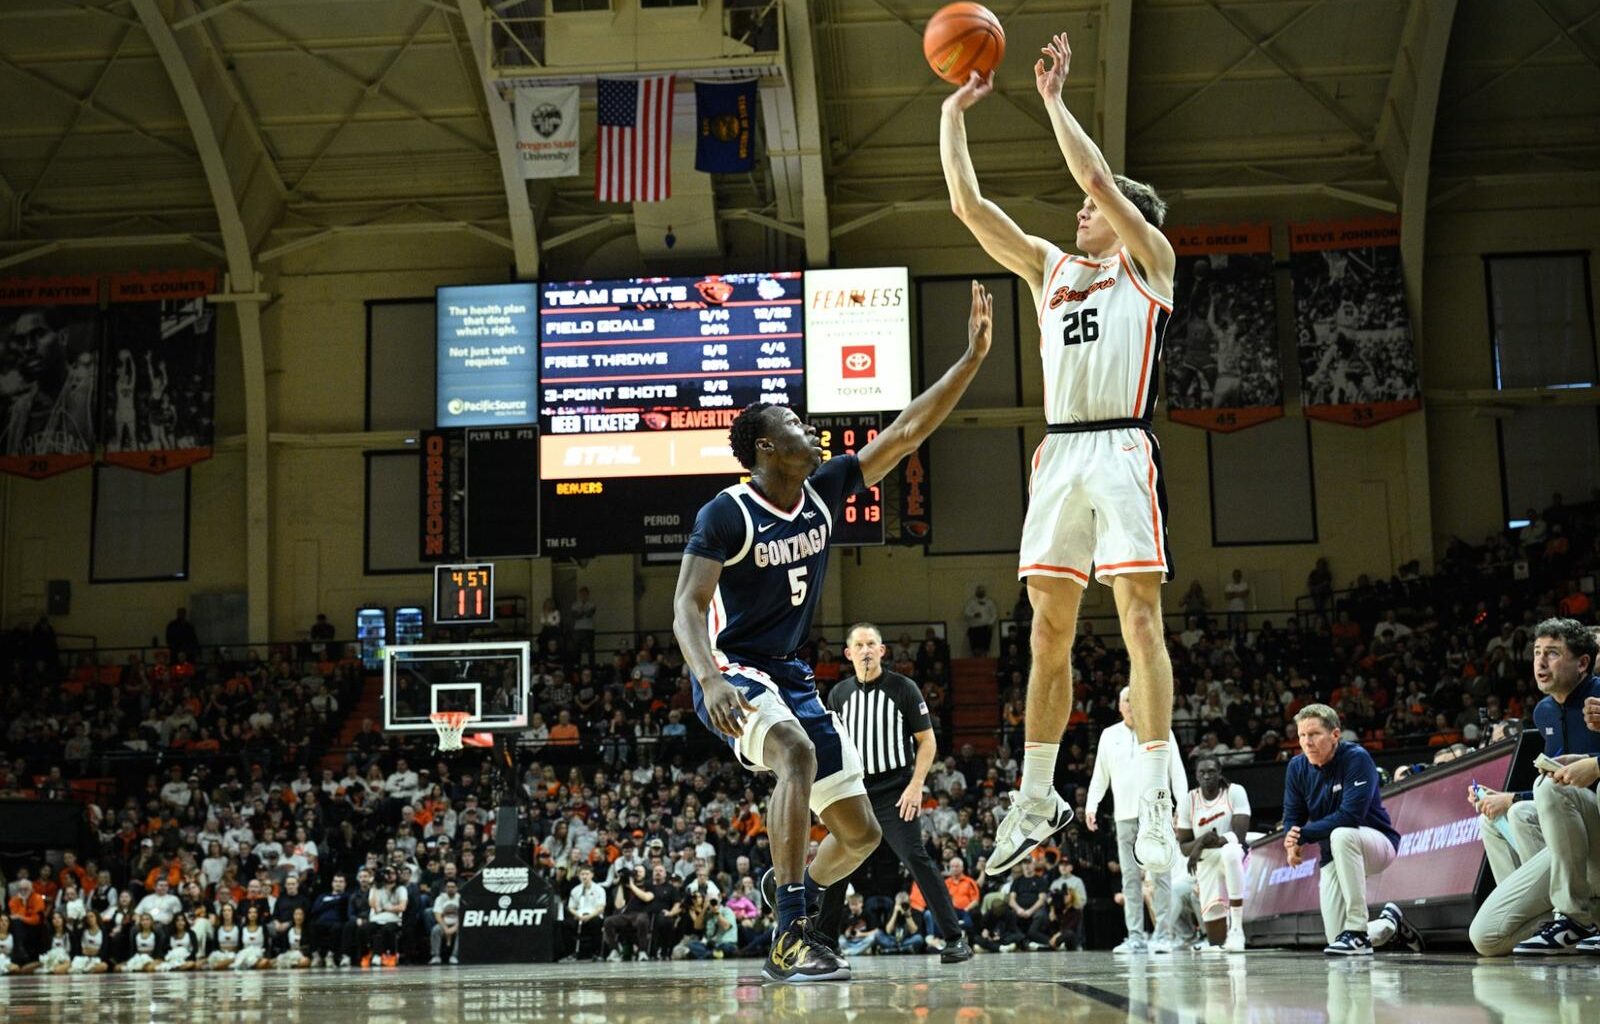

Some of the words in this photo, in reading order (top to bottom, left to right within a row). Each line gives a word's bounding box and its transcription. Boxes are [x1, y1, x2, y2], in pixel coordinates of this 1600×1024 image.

[516, 141, 552, 151] Oregon
[553, 140, 576, 149] State
[523, 151, 569, 161] University
[1206, 235, 1248, 246] GREEN
[1296, 232, 1333, 243] STEVE
[1339, 228, 1398, 240] JOHNSON
[39, 285, 91, 297] PAYTON
[151, 280, 206, 292] COUNTS
[544, 289, 608, 306] TEAM
[612, 286, 687, 303] STATS
[1049, 277, 1116, 309] Beavers
[449, 306, 468, 316] The
[469, 304, 502, 315] health
[503, 304, 526, 315] plan
[463, 317, 484, 326] that
[486, 316, 511, 325] does
[546, 321, 594, 335] FIELD
[597, 318, 655, 333] GOALS
[1063, 308, 1099, 345] 26
[456, 327, 489, 337] what's
[491, 326, 518, 337] right.
[448, 347, 468, 357] Not
[470, 346, 490, 357] just
[491, 345, 525, 355] what's
[760, 342, 786, 355] 4/4
[464, 356, 510, 368] required.
[544, 355, 589, 369] FREE
[591, 352, 668, 367] THROWS
[544, 387, 614, 402] 3-POINT
[618, 384, 677, 399] SHOTS
[837, 386, 882, 395] TOYOTA
[464, 400, 527, 412] PacificSource
[583, 413, 639, 432] TICKETS?
[470, 431, 491, 441] PLYR
[494, 430, 510, 440] FLS
[517, 429, 533, 439] PTS
[820, 430, 831, 447] 2
[844, 430, 855, 446] 0
[556, 482, 603, 495] BEAVERS
[426, 435, 444, 555] OREGON
[846, 506, 857, 523] 0
[864, 505, 880, 522] 13
[644, 515, 681, 527] PERIOD
[546, 538, 559, 548] TM
[560, 537, 577, 548] FLS
[645, 534, 661, 545] TIME
[663, 533, 684, 545] OUTS
[787, 565, 808, 607] 5
[458, 588, 483, 616] 11
